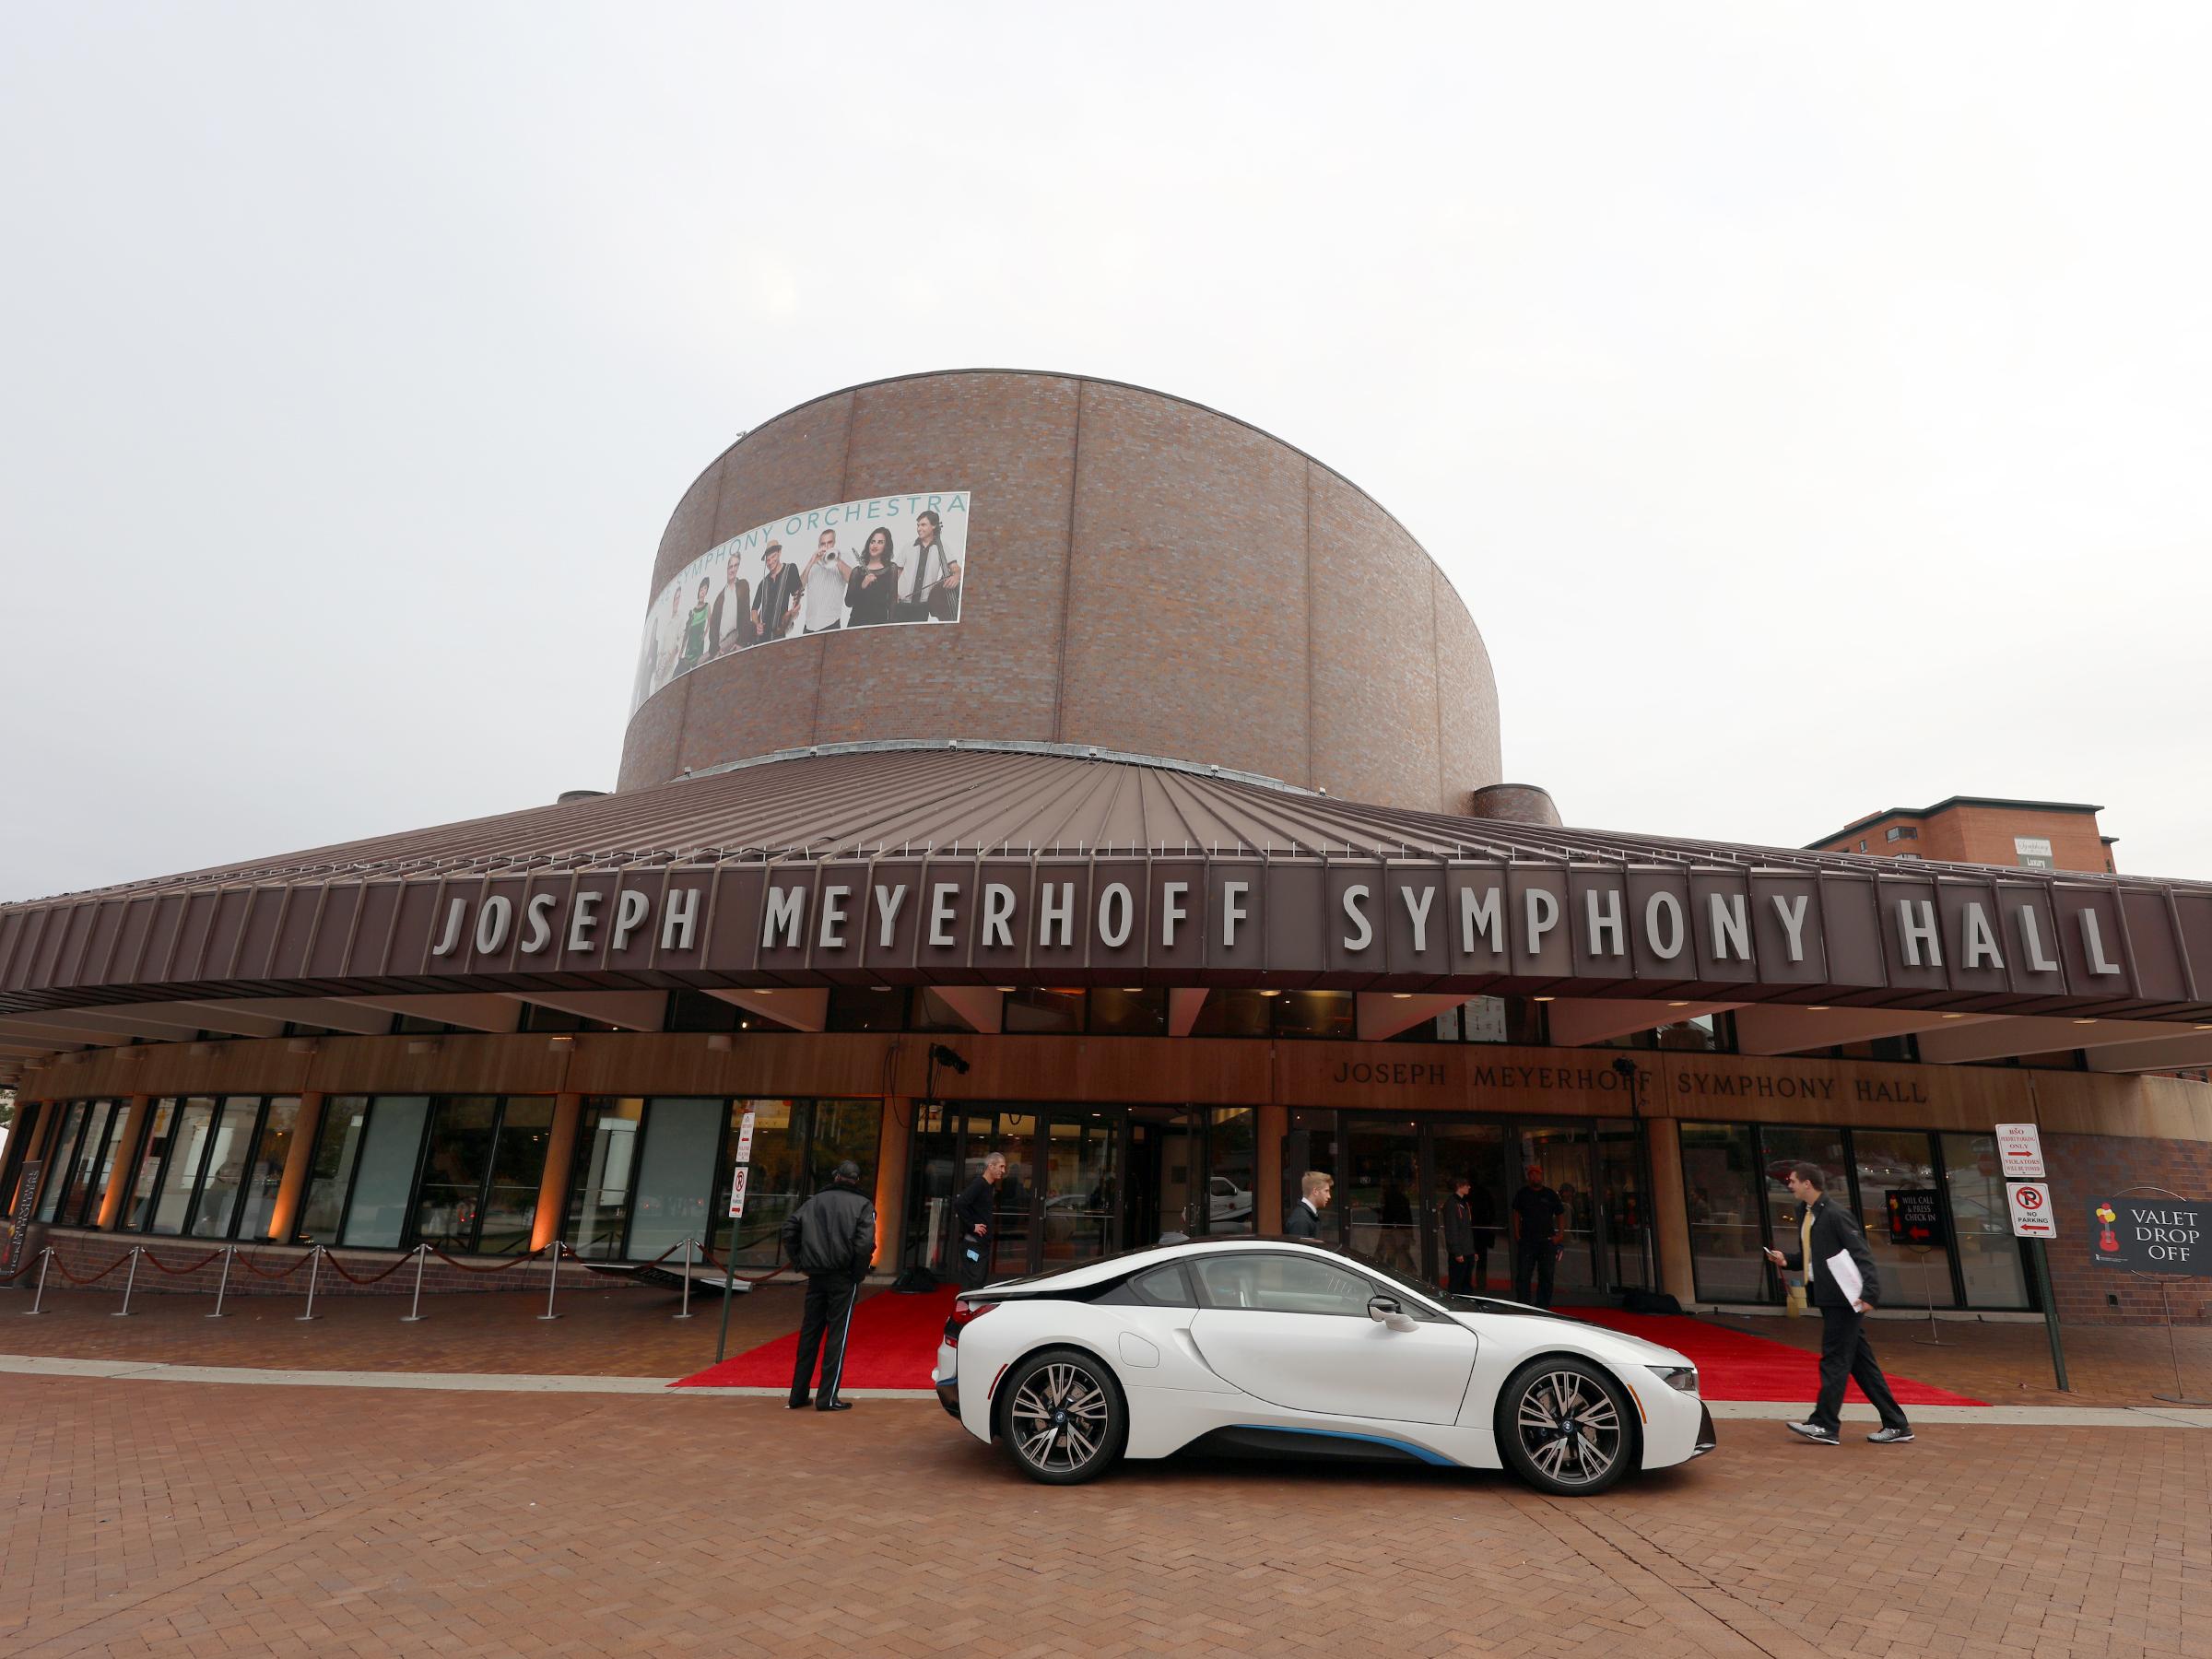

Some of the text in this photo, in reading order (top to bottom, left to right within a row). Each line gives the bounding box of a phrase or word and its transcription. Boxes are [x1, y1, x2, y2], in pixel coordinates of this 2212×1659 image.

[677, 494, 966, 585] SYMPHONY ORCHESTRA
[432, 881, 2121, 975] JOSEPH MEYERHOFF SYMPHONY HALL
[1334, 1062, 1446, 1086] JOSEPH
[1677, 1073, 1835, 1100] SYMPHONY
[1854, 1079, 1928, 1104] HALL
[1902, 1196, 1935, 1205] WILL CALL
[1913, 1205, 1931, 1213] PRESS
[2131, 1209, 2198, 1227] VALET
[2136, 1227, 2200, 1244] DROP
[2147, 1245, 2191, 1262] OFF
